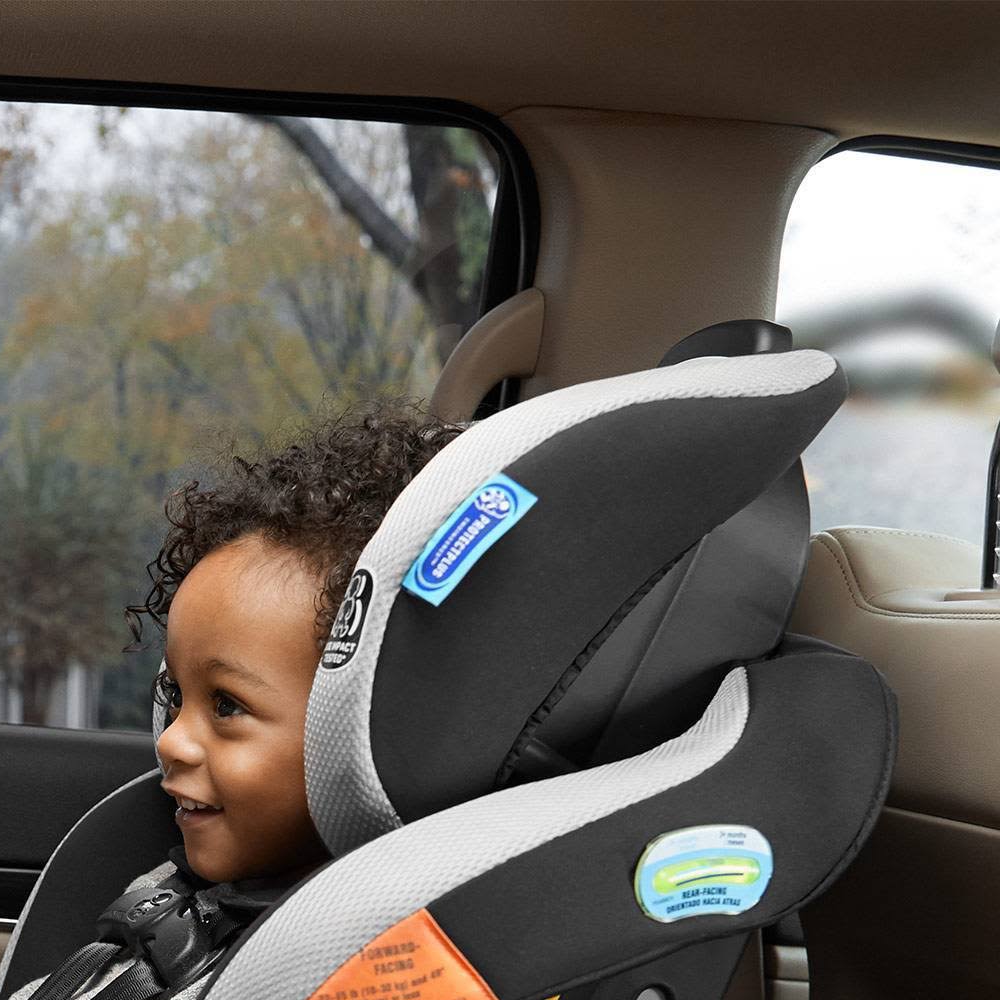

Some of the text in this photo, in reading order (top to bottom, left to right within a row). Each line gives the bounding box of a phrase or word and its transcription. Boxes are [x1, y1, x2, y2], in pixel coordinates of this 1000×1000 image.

[432, 512, 491, 579] PROTECTPLUS
[681, 888, 727, 899] REAR-FACING
[374, 958, 414, 975] FACING
